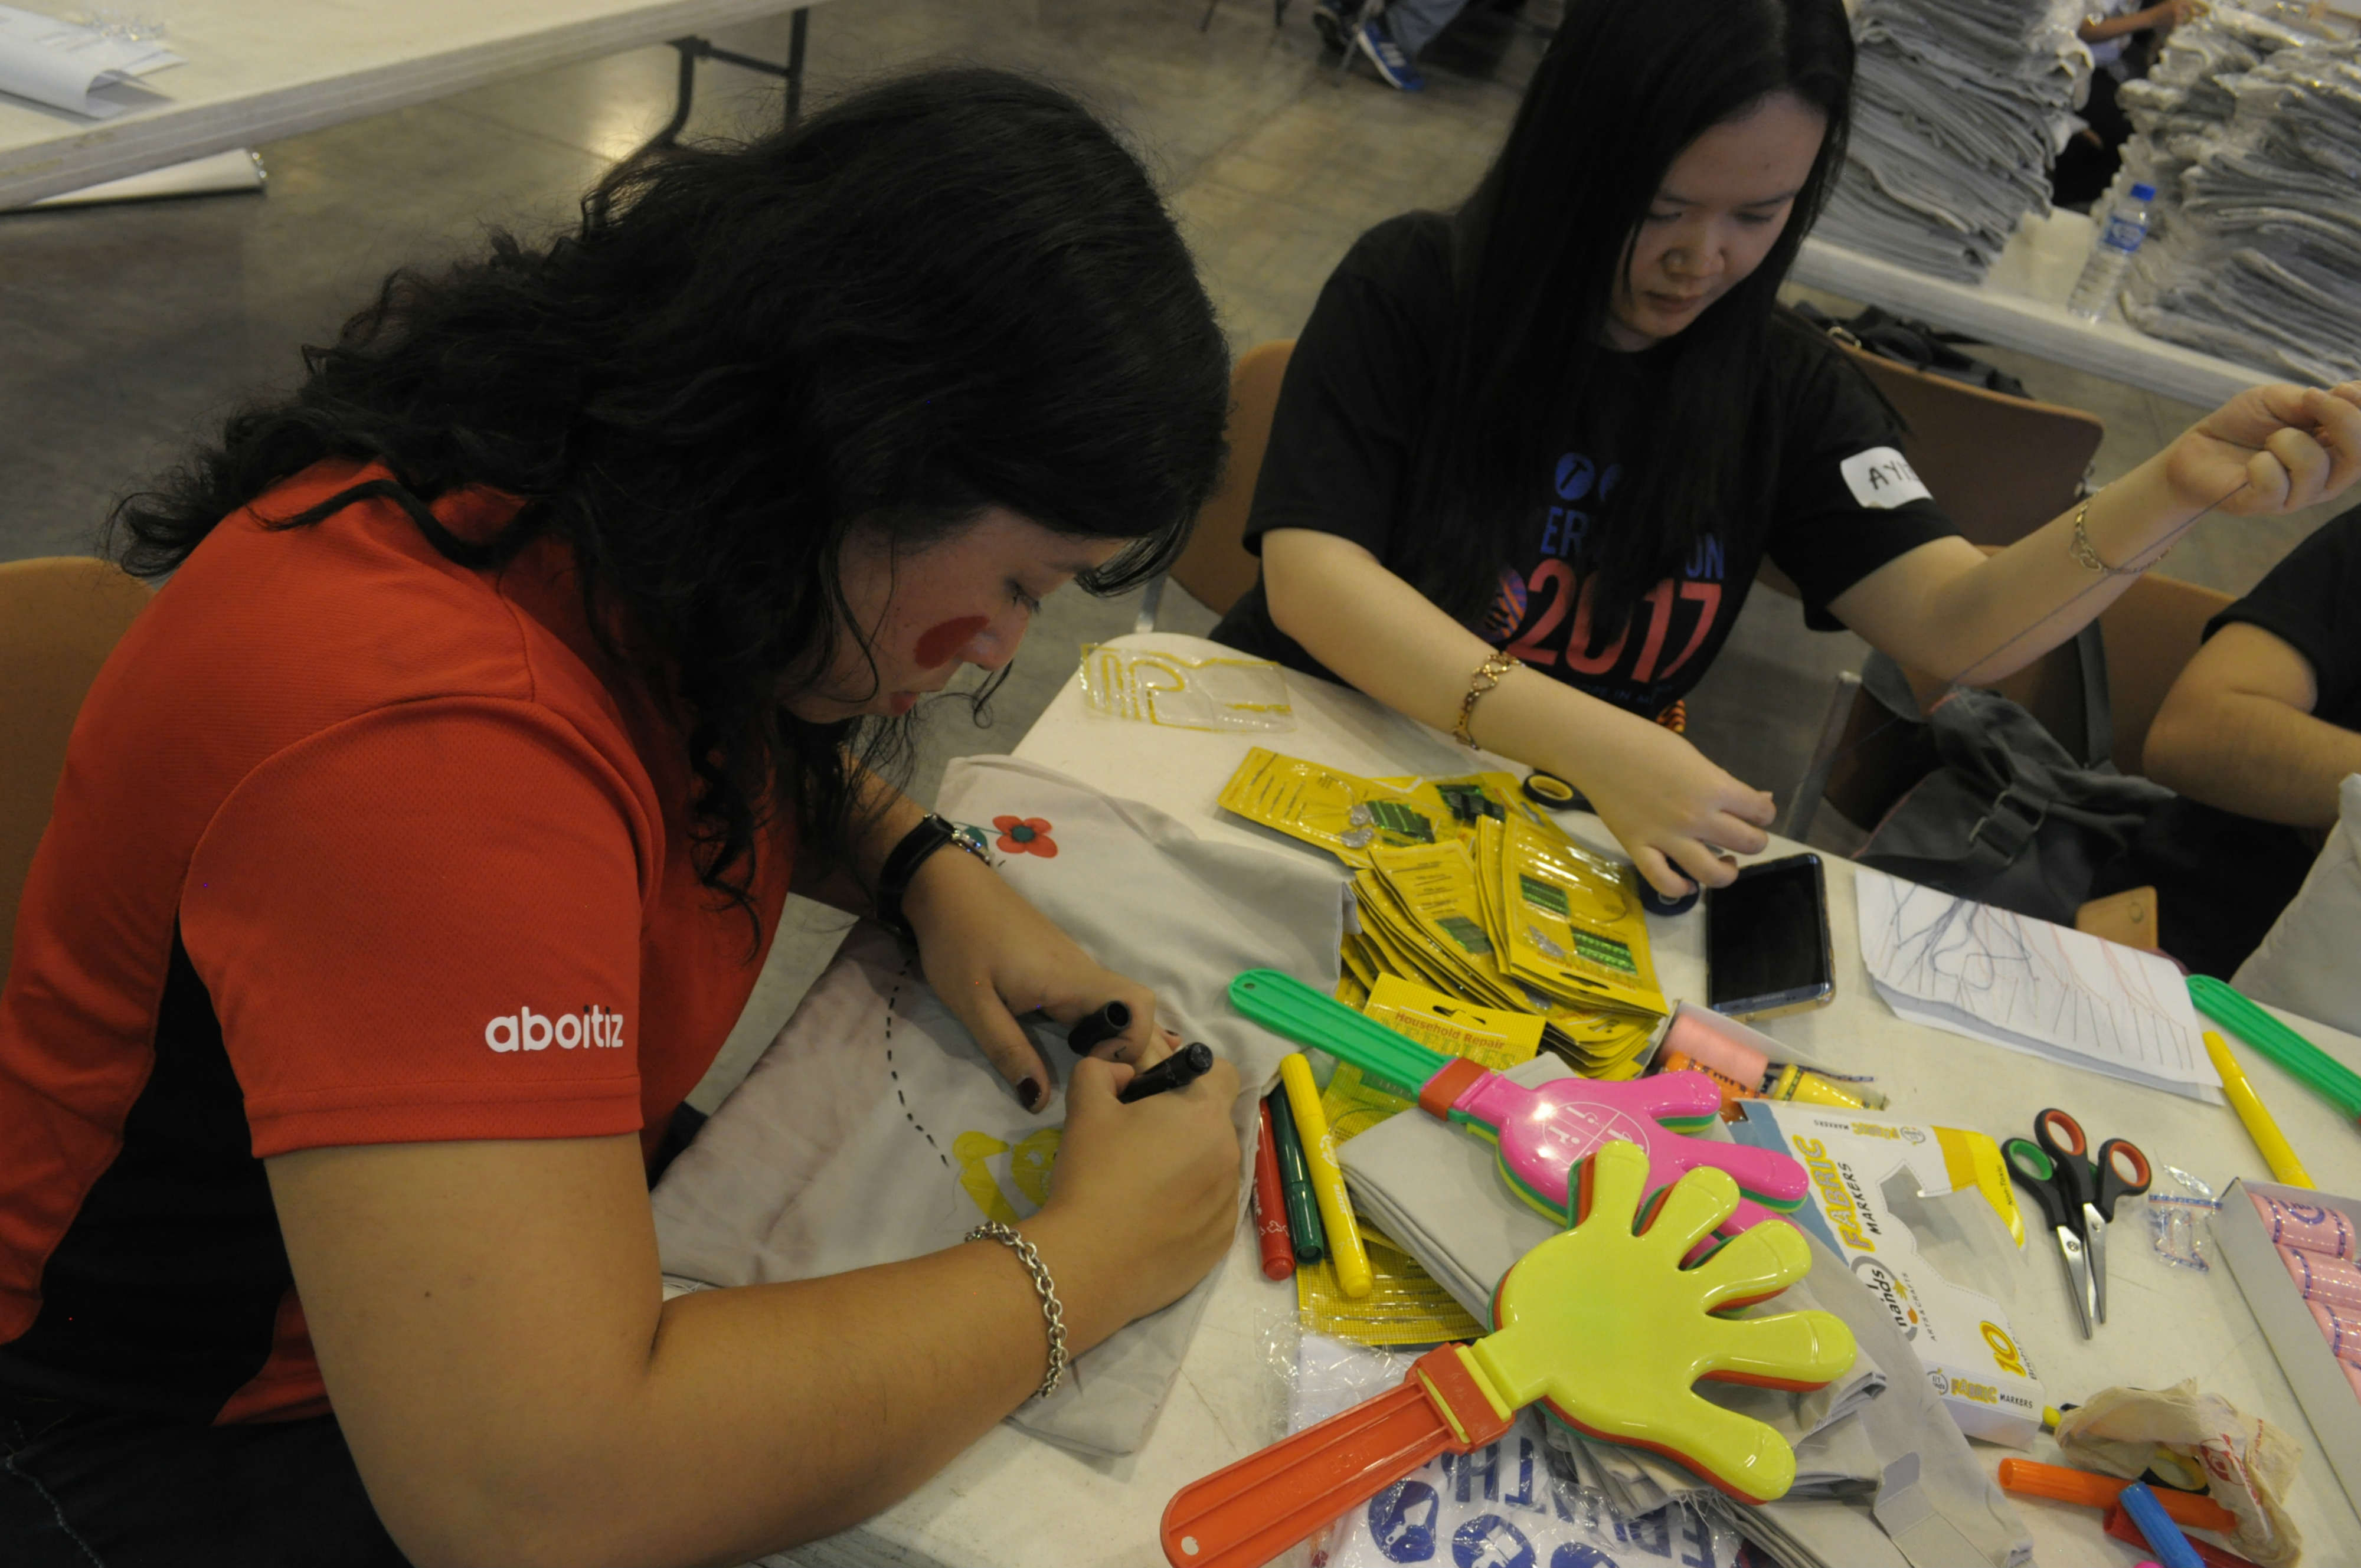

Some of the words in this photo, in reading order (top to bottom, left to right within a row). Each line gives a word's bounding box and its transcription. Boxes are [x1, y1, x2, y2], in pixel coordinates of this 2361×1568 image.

[1505, 558, 1722, 683] 2017
[485, 1004, 623, 1052] aboitiz
[1395, 1011, 1461, 1040] Household
[1463, 1033, 1505, 1050] Repair
[1793, 1134, 1876, 1252] FABRIC
[1837, 1161, 1882, 1235] MARKERS
[1901, 1272, 1922, 1308] CRAFTS
[1979, 1320, 2026, 1377] 10
[1951, 1378, 1997, 1404] FABRIC
[2000, 1393, 2033, 1409] MARKERS
